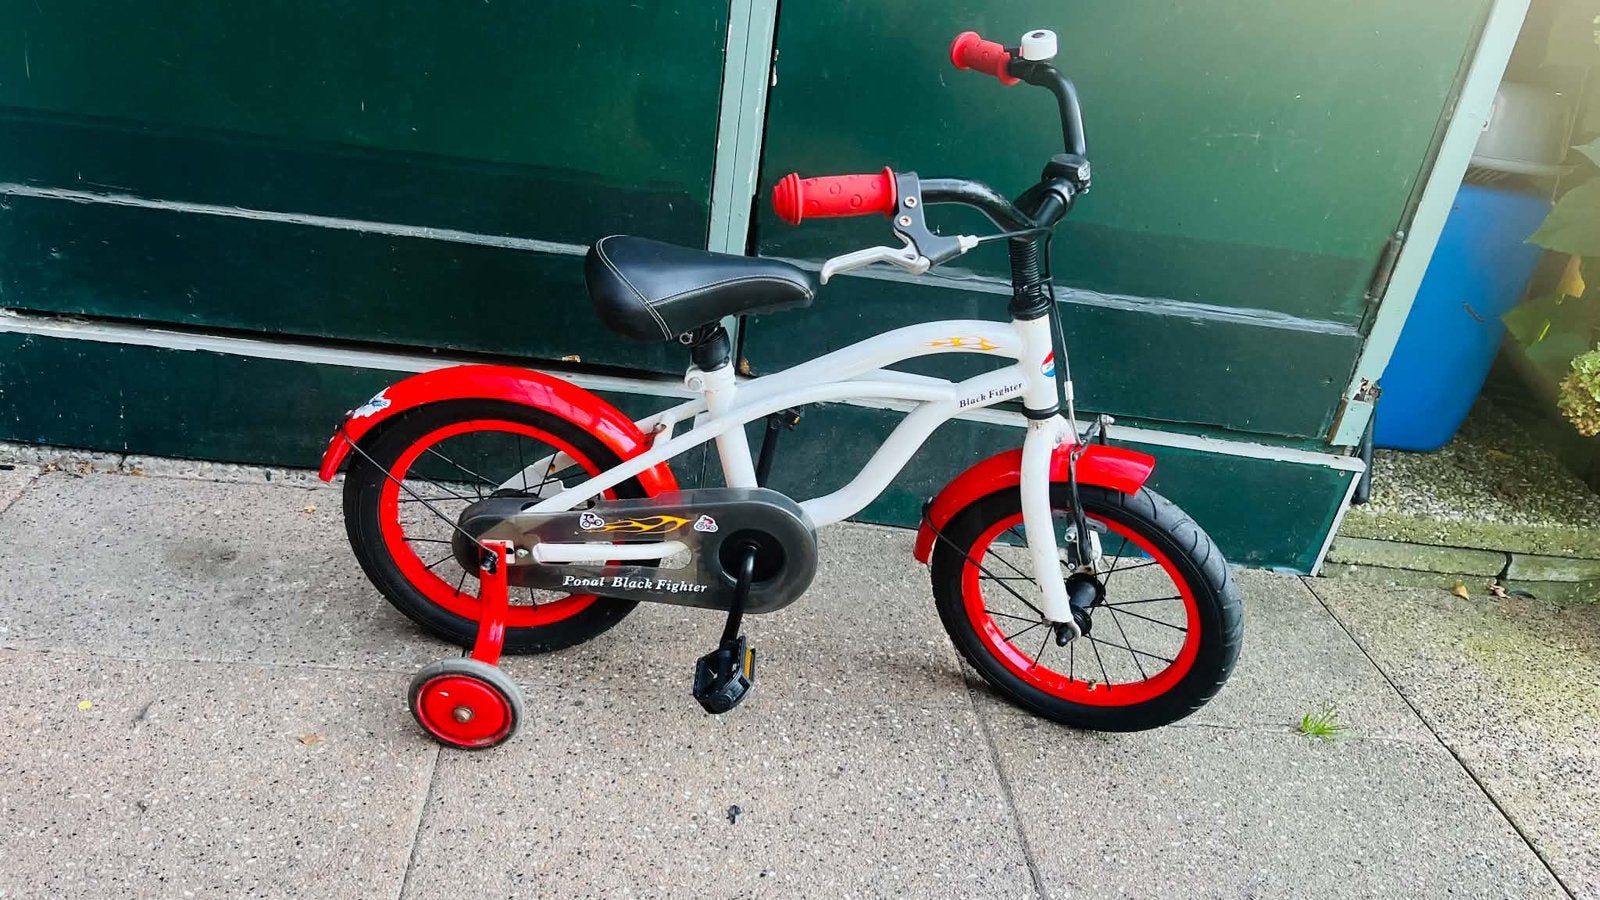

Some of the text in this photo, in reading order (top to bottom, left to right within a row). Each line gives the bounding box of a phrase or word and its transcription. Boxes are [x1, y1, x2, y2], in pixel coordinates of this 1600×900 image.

[960, 383, 1022, 408] Black Fighter
[611, 576, 653, 589] Black
[655, 579, 708, 593] Fighter
